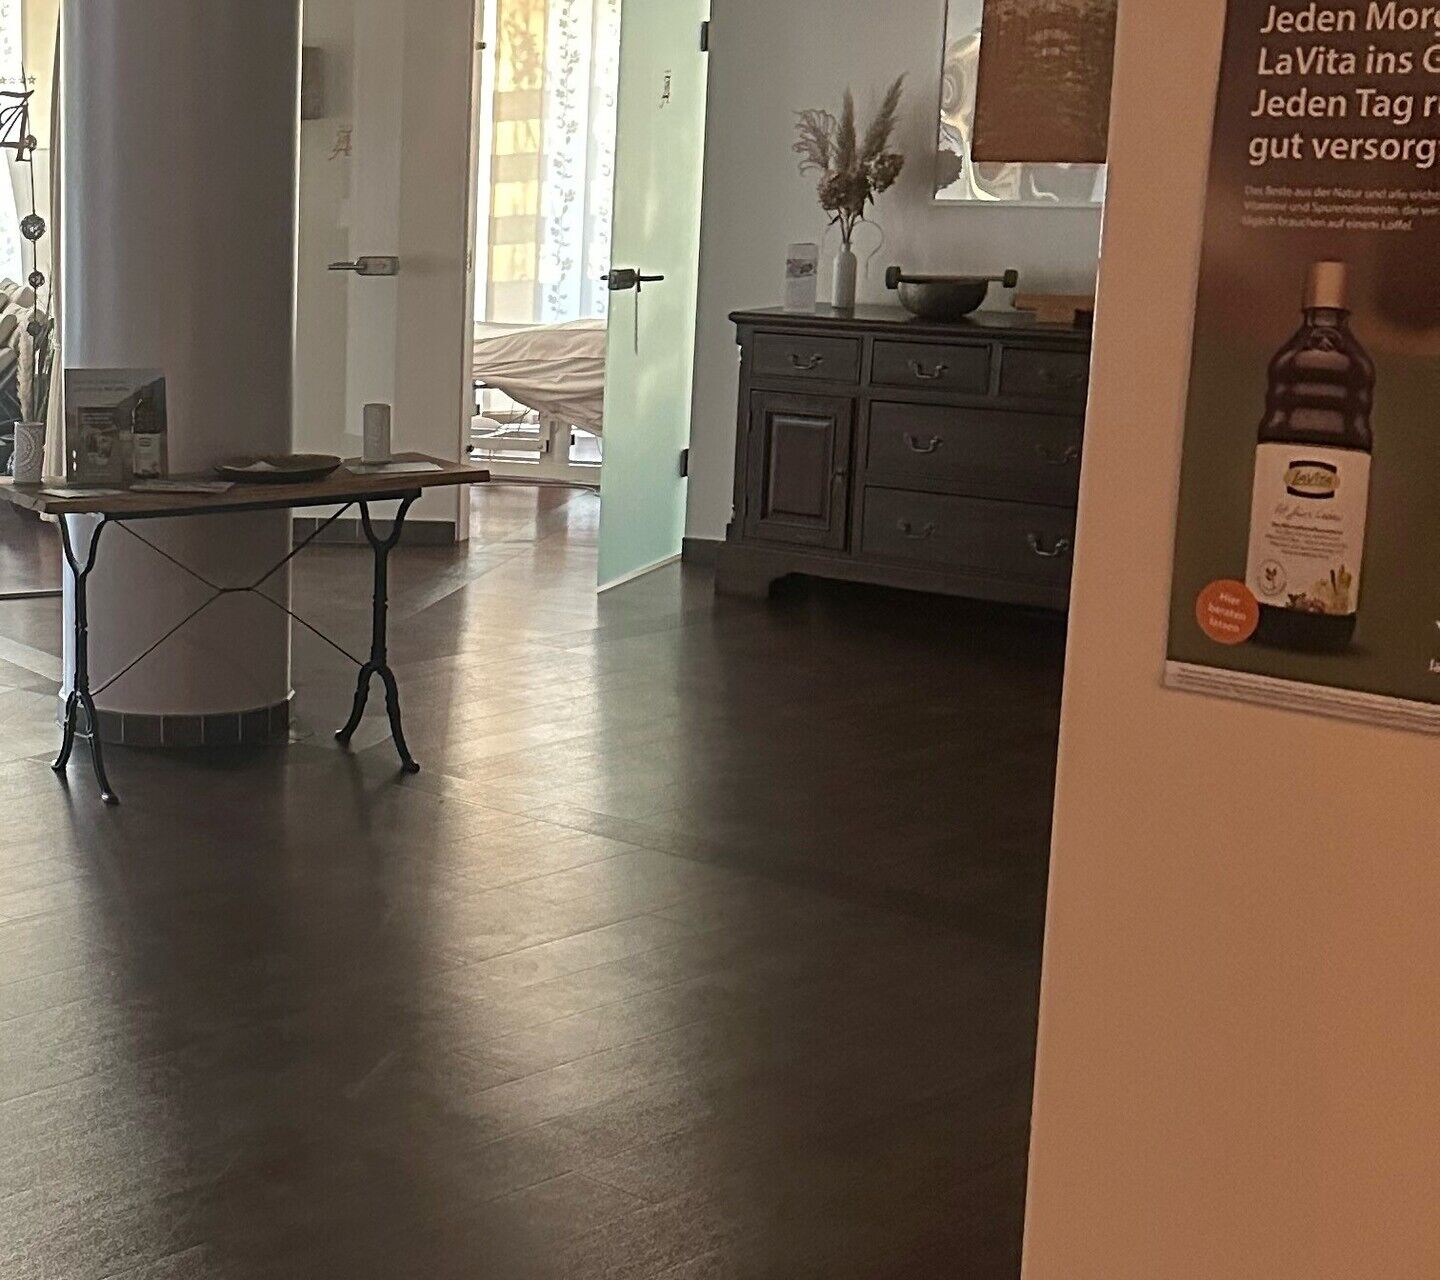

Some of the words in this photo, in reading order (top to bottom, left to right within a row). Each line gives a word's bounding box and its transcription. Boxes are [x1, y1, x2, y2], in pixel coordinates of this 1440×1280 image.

[1260, 1, 1356, 35] Jeden
[1257, 45, 1357, 75] LaVita
[1364, 44, 1413, 75] ins
[1250, 87, 1348, 118] Jeden
[1355, 87, 1414, 126] Tag
[1248, 132, 1304, 167] gut
[1311, 136, 1440, 169] versorg
